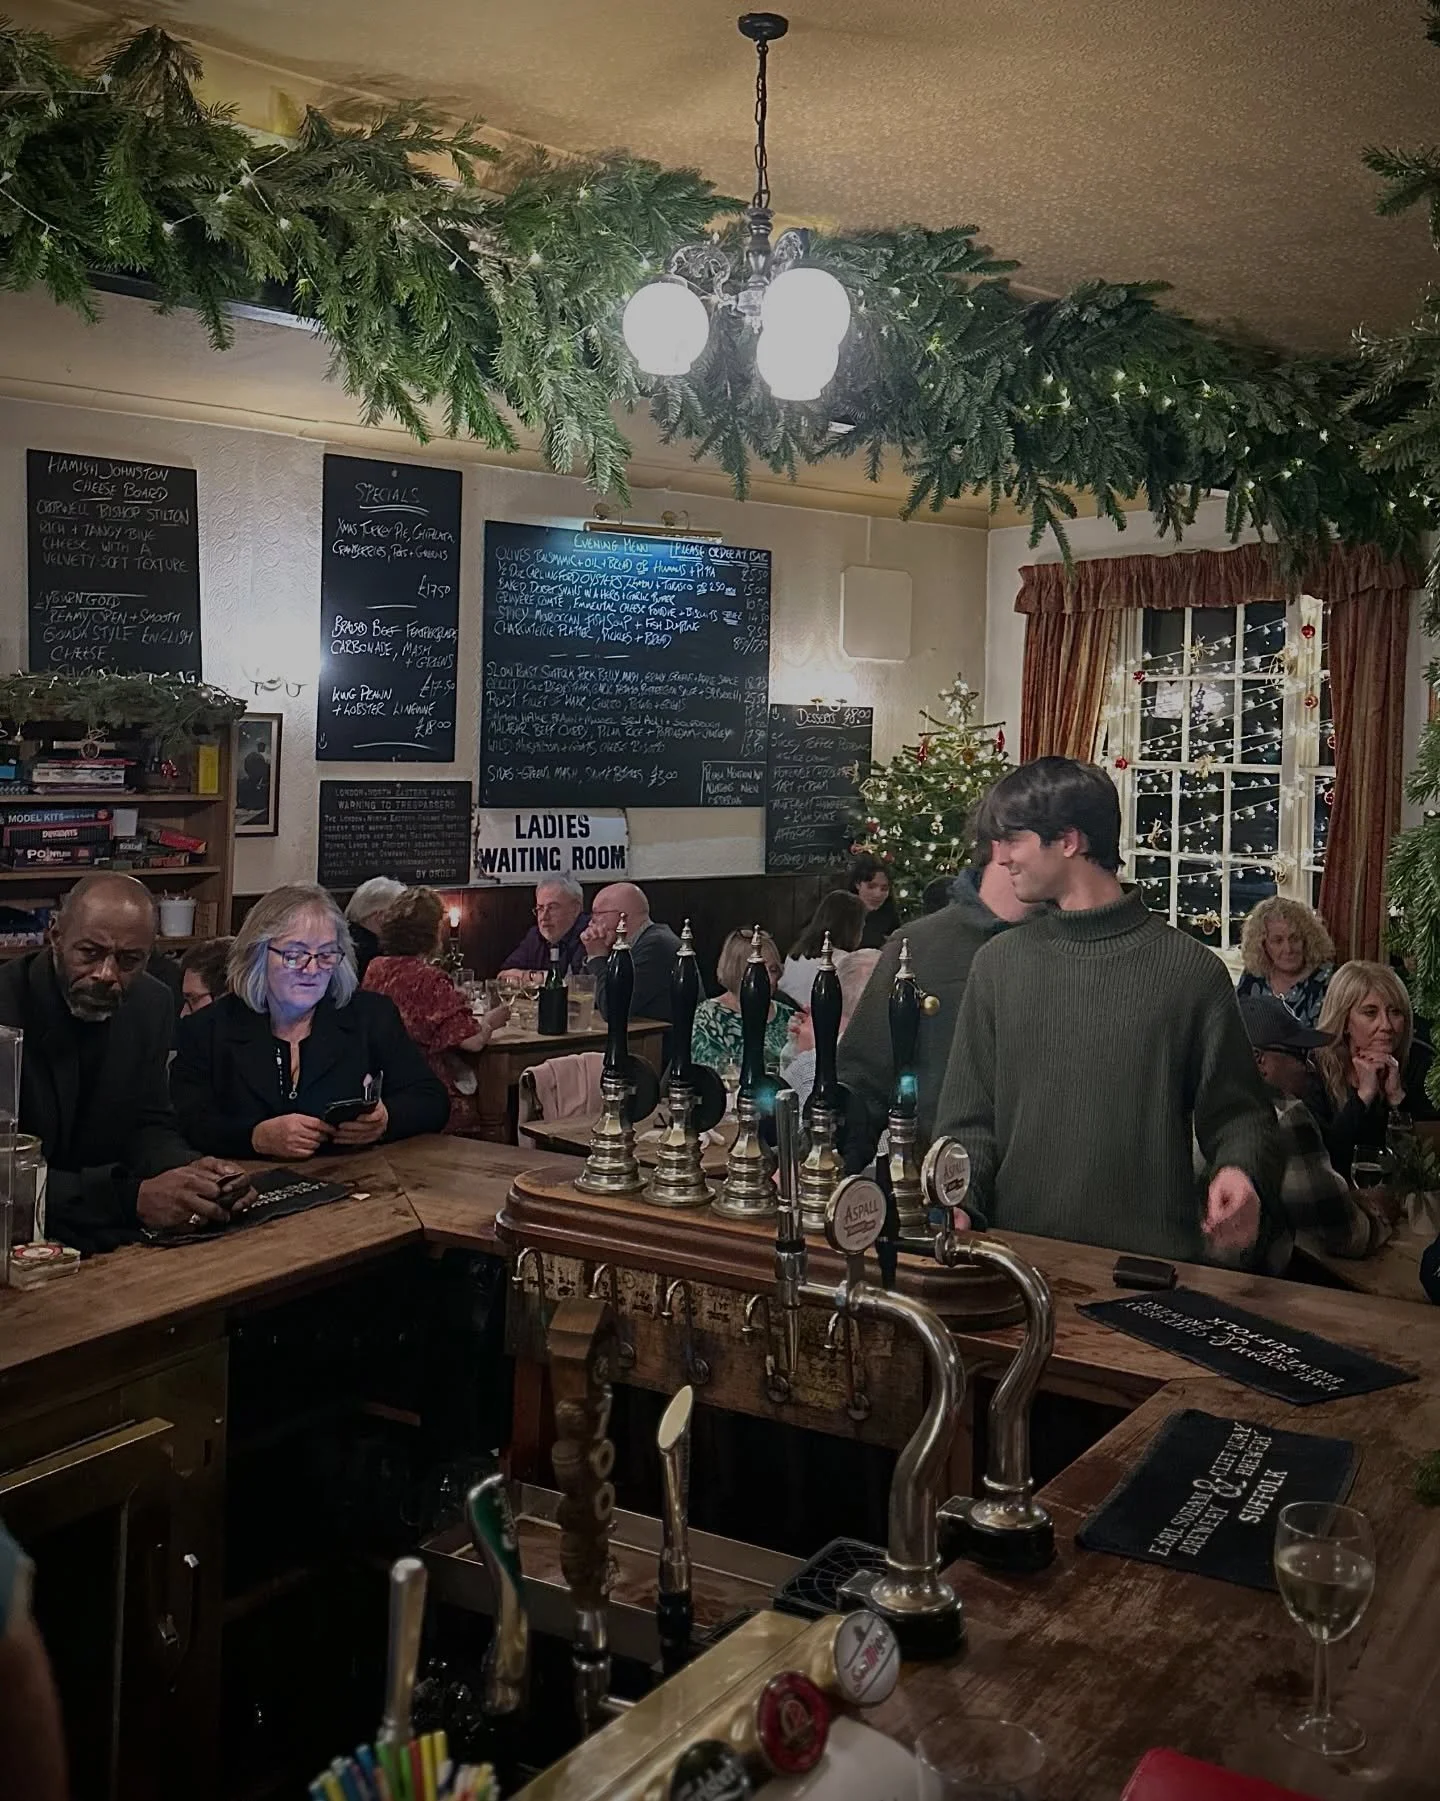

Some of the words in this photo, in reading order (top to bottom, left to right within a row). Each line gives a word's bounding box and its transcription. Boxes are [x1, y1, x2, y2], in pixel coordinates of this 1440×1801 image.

[48, 456, 98, 476] HAMISH
[99, 463, 168, 481] JOHNSTON
[73, 479, 117, 496] CHEESE
[123, 482, 168, 502] BOARD
[355, 482, 420, 503] SPECIALS
[97, 503, 140, 519] BISHOP
[147, 507, 189, 525] STILTON
[40, 520, 64, 533] RICH
[83, 523, 122, 539] TANGY
[125, 527, 156, 540] BLUE
[42, 537, 89, 550] CHEESE
[102, 541, 129, 552] WITH
[140, 543, 152, 556] A
[415, 545, 448, 560] GREENS
[573, 533, 618, 551] EVENING
[623, 537, 649, 553] MENU
[674, 542, 705, 558] PLEASE
[749, 550, 768, 562] BAR
[134, 557, 188, 572] TEXTURE
[495, 546, 531, 562] OLIVES
[584, 558, 602, 569] OIL
[607, 556, 633, 573] BREAD
[497, 577, 526, 594] BAKED
[625, 579, 654, 591] LEMON
[86, 592, 120, 608] GOLD
[619, 602, 647, 614] CHEESE
[92, 608, 127, 624] OPEN
[139, 609, 181, 623] SMOOTH
[495, 605, 529, 624] SPICY
[534, 609, 580, 624] MOROCCAN
[645, 618, 662, 630] FISH
[43, 625, 88, 643] GOUDA
[92, 625, 137, 643] STYLE
[142, 626, 193, 645] ENGLISH
[331, 615, 368, 638] BRAISED
[372, 619, 403, 638] BEEF
[494, 620, 554, 637] CHARCUTERIE
[645, 632, 672, 649] BREAD
[402, 641, 432, 657] MASH
[405, 658, 413, 668] +
[415, 653, 454, 669] GREENS
[486, 661, 513, 677] SLOW
[332, 686, 358, 703] KING
[360, 684, 393, 702] PRAWN
[332, 704, 342, 716] +
[344, 702, 386, 716] LOBSTER
[795, 708, 837, 727] DESSERTS
[338, 800, 376, 810] WARNING
[382, 800, 391, 810] TO
[395, 800, 456, 810] TRESPASSERS
[8, 814, 42, 824] MODEL
[43, 813, 64, 823] KITS
[515, 814, 590, 840] LADIES
[480, 846, 561, 873] WAITING
[572, 845, 626, 871] ROOM
[415, 869, 426, 879] BY
[429, 868, 457, 878] ORDER
[845, 1199, 879, 1222] ASPALL
[1205, 1316, 1302, 1354] SUFFOLK
[1209, 1444, 1243, 1478] CLIFF
[1235, 1430, 1273, 1478] BREWERY
[1192, 1477, 1248, 1498] &
[1238, 1468, 1289, 1524] SUFFOLK
[1178, 1504, 1231, 1556] BREWERY
[1148, 1526, 1184, 1557] EARL
